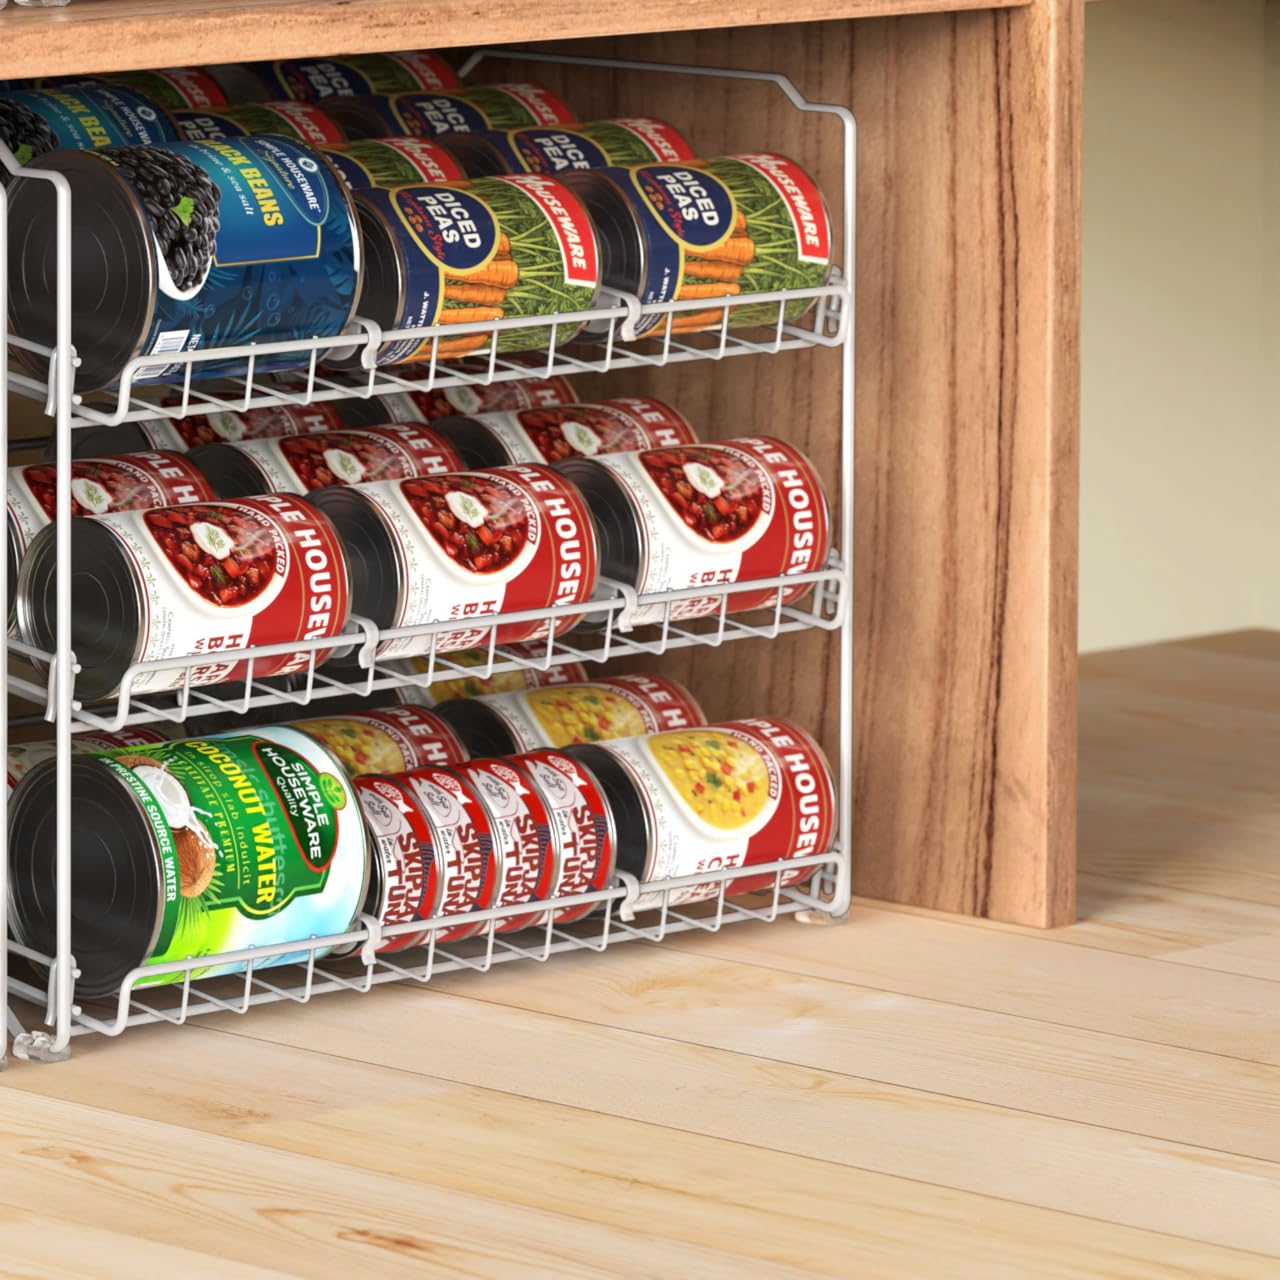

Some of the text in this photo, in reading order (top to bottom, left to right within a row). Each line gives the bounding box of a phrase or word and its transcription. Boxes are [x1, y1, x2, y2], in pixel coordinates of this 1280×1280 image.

[225, 173, 254, 216] sea salt
[239, 175, 284, 228] BEANS
[254, 139, 321, 212] SIMPLE HOUSEWARE
[656, 175, 699, 222] PEAS
[673, 171, 720, 227] DICED
[416, 196, 460, 244] PEAS
[434, 192, 482, 249] DICED
[238, 505, 286, 575] HAND PACKED
[520, 497, 538, 544] PACKED
[261, 747, 322, 860] HOUSEWARE
[276, 776, 300, 818] Quality
[291, 762, 329, 827] SIMPLE
[763, 753, 779, 800] PACKED
[186, 741, 266, 817] COCONUT
[251, 823, 277, 906] WATER
[196, 760, 252, 886] sirop slab indulcit
[147, 806, 172, 854] SOURCE
[164, 857, 176, 902] WATER
